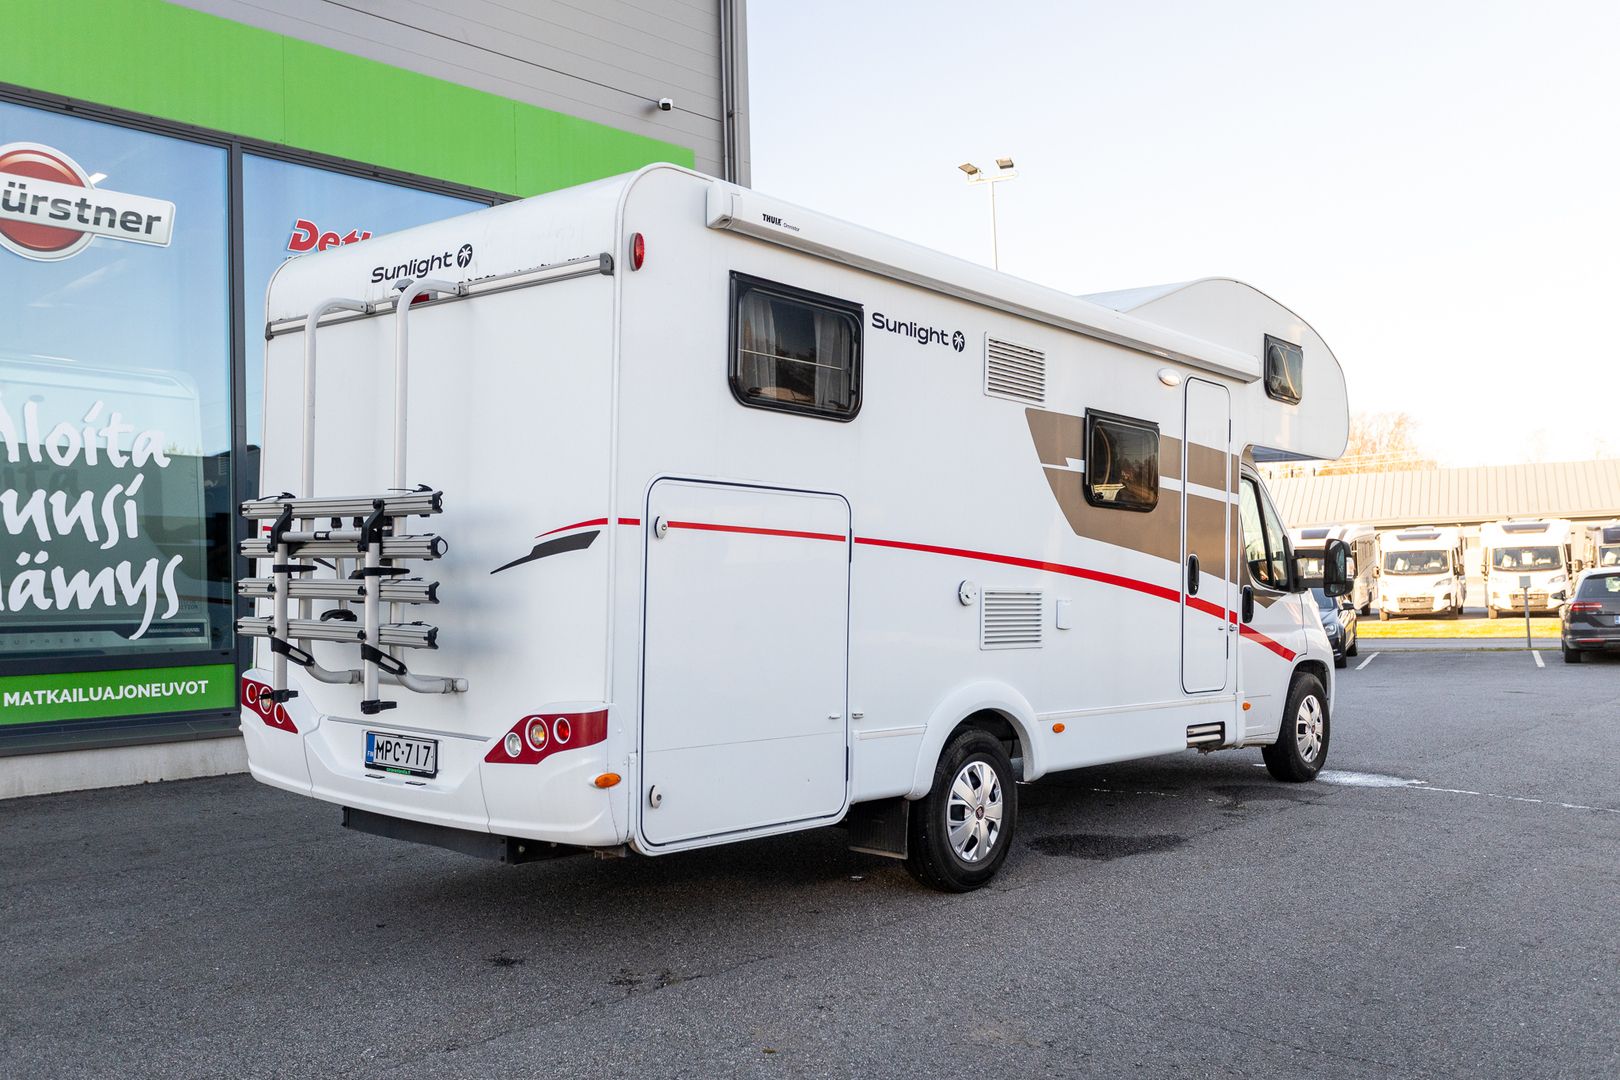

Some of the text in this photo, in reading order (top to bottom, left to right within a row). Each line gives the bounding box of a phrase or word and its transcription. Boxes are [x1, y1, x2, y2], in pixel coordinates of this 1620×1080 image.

[0, 181, 162, 235] ürstner
[762, 213, 783, 226] THULE
[371, 251, 453, 283] Sunlight
[871, 312, 949, 346] Sunlight
[0, 473, 144, 549] uusi
[0, 550, 183, 640] ämys
[3, 680, 209, 707] MATKAILUAJONEUVOT
